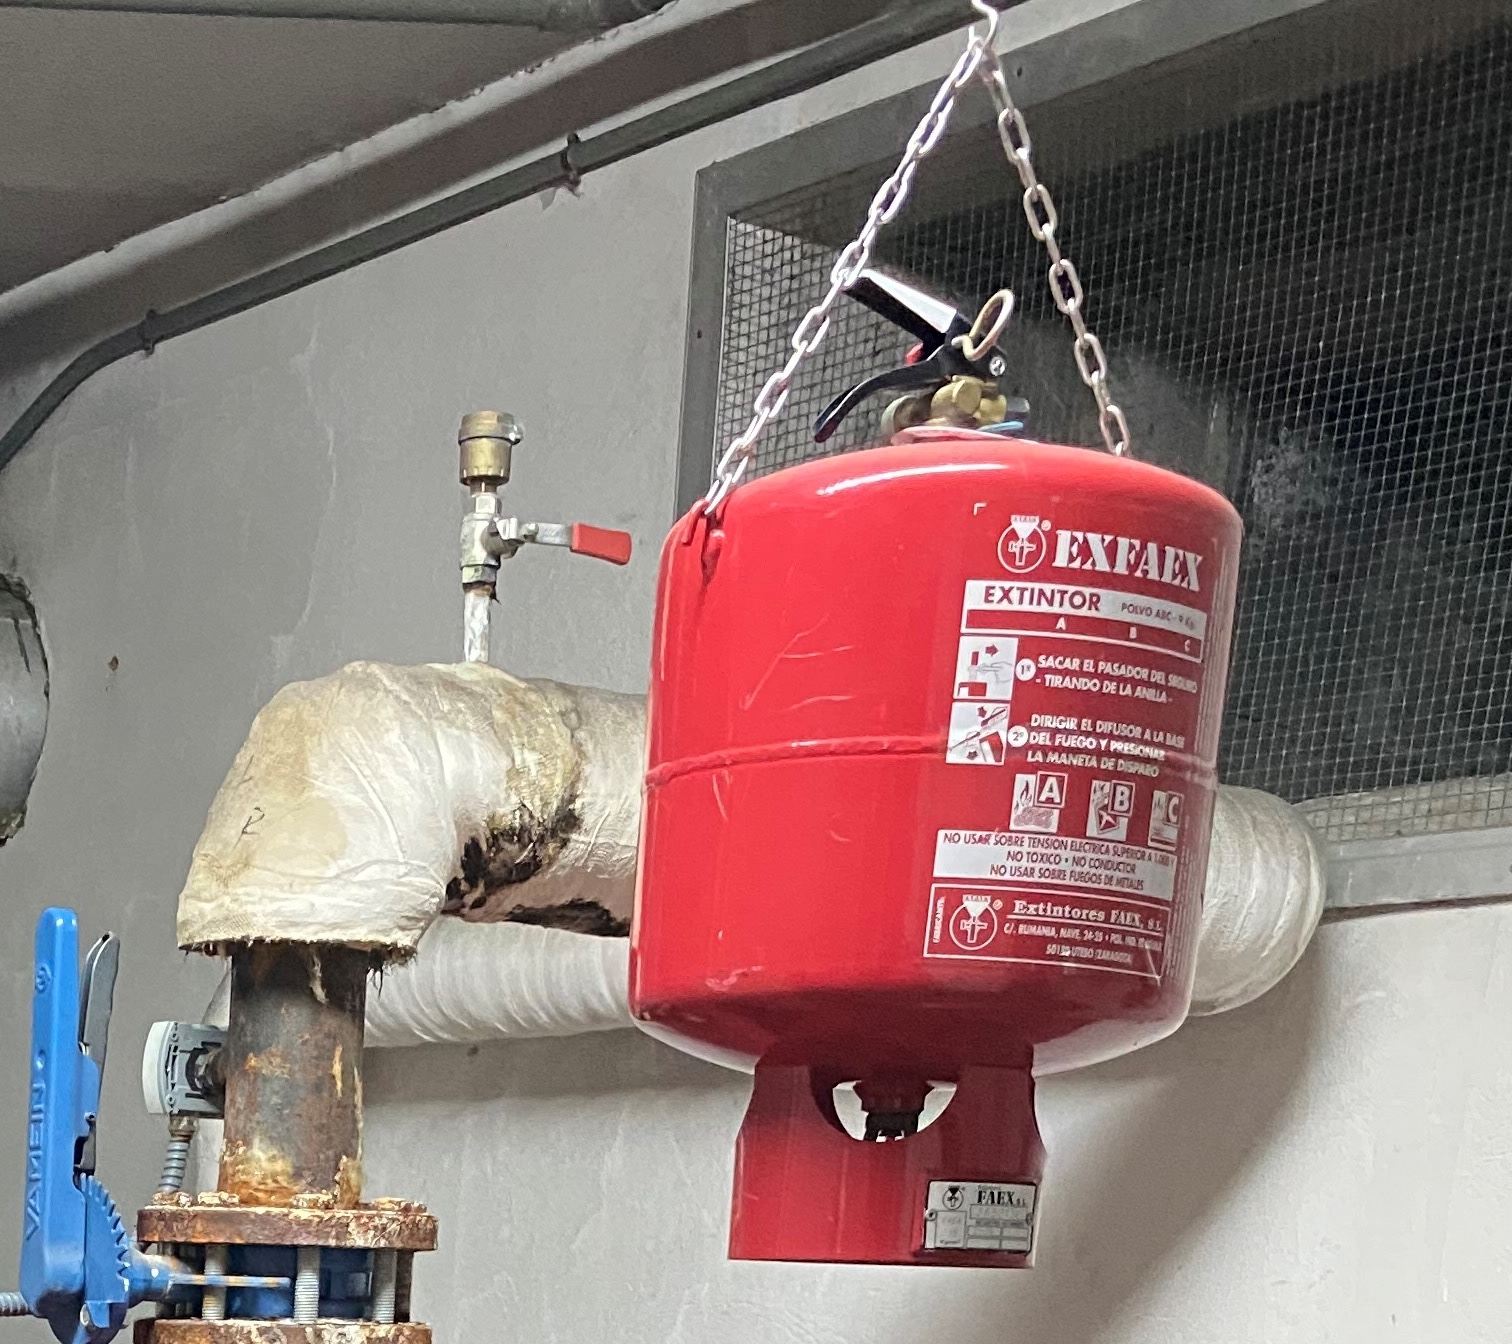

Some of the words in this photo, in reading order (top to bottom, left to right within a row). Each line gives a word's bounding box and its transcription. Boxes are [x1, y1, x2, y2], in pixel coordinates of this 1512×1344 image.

[1052, 529, 1203, 592] EXFAEX
[984, 585, 1101, 612] EXTINTOR
[1121, 602, 1153, 617] POLVO
[1155, 609, 1172, 622] ABC
[1055, 616, 1066, 630] A
[1184, 639, 1191, 652] C
[1037, 654, 1080, 671] SACAR
[1082, 659, 1095, 673] EL
[1097, 661, 1149, 681] PASADOR
[1150, 670, 1166, 686] DEL
[1044, 674, 1100, 692] TIRANDO
[1101, 680, 1117, 694] DE
[1119, 682, 1132, 697] LA
[1133, 686, 1168, 704] ANILLA
[1030, 713, 1078, 730] DIRIGIR
[1080, 718, 1094, 732] EL
[1095, 720, 1142, 739] DIFUSOR
[1143, 728, 1151, 741] A
[1153, 731, 1165, 743] LA
[1028, 731, 1052, 746] DEL
[1054, 733, 1097, 750] FUEGO
[1099, 738, 1108, 751] Y
[1110, 739, 1166, 761] PRESIONAR
[1027, 750, 1044, 763] LA
[1046, 752, 1098, 768] MANETA
[1100, 757, 1116, 770] DE
[1116, 758, 1160, 778] DISPARO
[1039, 776, 1061, 803] A
[1114, 784, 1130, 812] B
[1167, 796, 1179, 823] C
[943, 832, 961, 844] NO
[964, 832, 992, 846] USAR
[993, 834, 1025, 848] SOBRE
[1027, 836, 1068, 851] TENSION
[1069, 840, 1110, 856] ELECTRICA
[1111, 846, 1146, 861] SUPERIOR
[989, 863, 1007, 877] NO
[1009, 865, 1035, 879] USAR
[1038, 867, 1067, 881] SOBRE
[1068, 869, 1102, 885] FUEGOS
[1103, 874, 1113, 887] DE
[1114, 877, 1144, 891] METALES
[1006, 850, 1024, 862] NO
[1026, 851, 1062, 866] TOXICO
[1071, 855, 1087, 868] NO
[1088, 858, 1136, 875] CONDUCTOR
[1013, 899, 1106, 922] Extintores
[25, 1081, 46, 1241] VAMEIN
[977, 1190, 1015, 1205] FAEX
